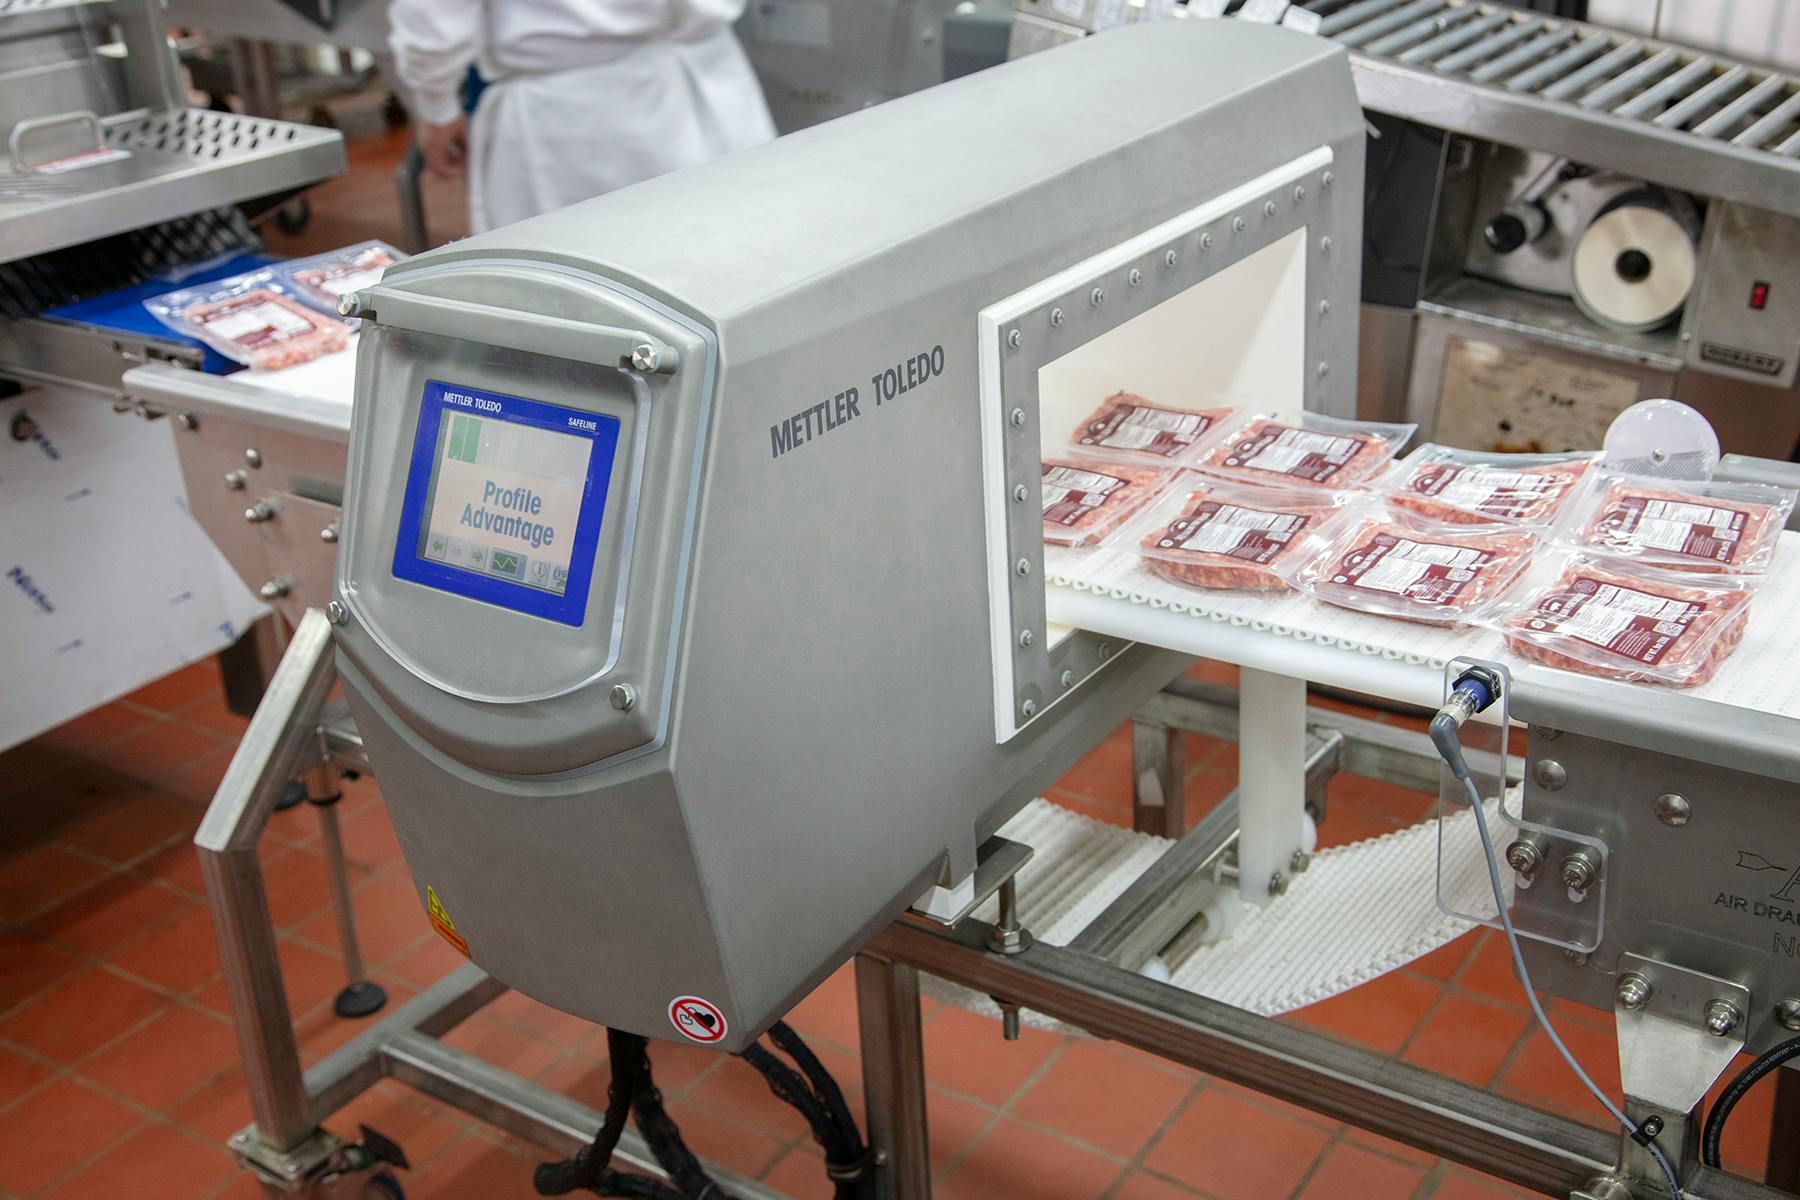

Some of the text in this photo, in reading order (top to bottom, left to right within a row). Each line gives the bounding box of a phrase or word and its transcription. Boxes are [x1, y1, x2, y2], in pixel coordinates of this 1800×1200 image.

[443, 391, 502, 413] METTLER TOLEDO
[770, 345, 945, 459] METTLER TOLEDO
[568, 416, 597, 431] SAFELINE
[482, 479, 542, 516] Profile
[459, 502, 555, 549] Advantage
[1714, 891, 1748, 913] AIR
